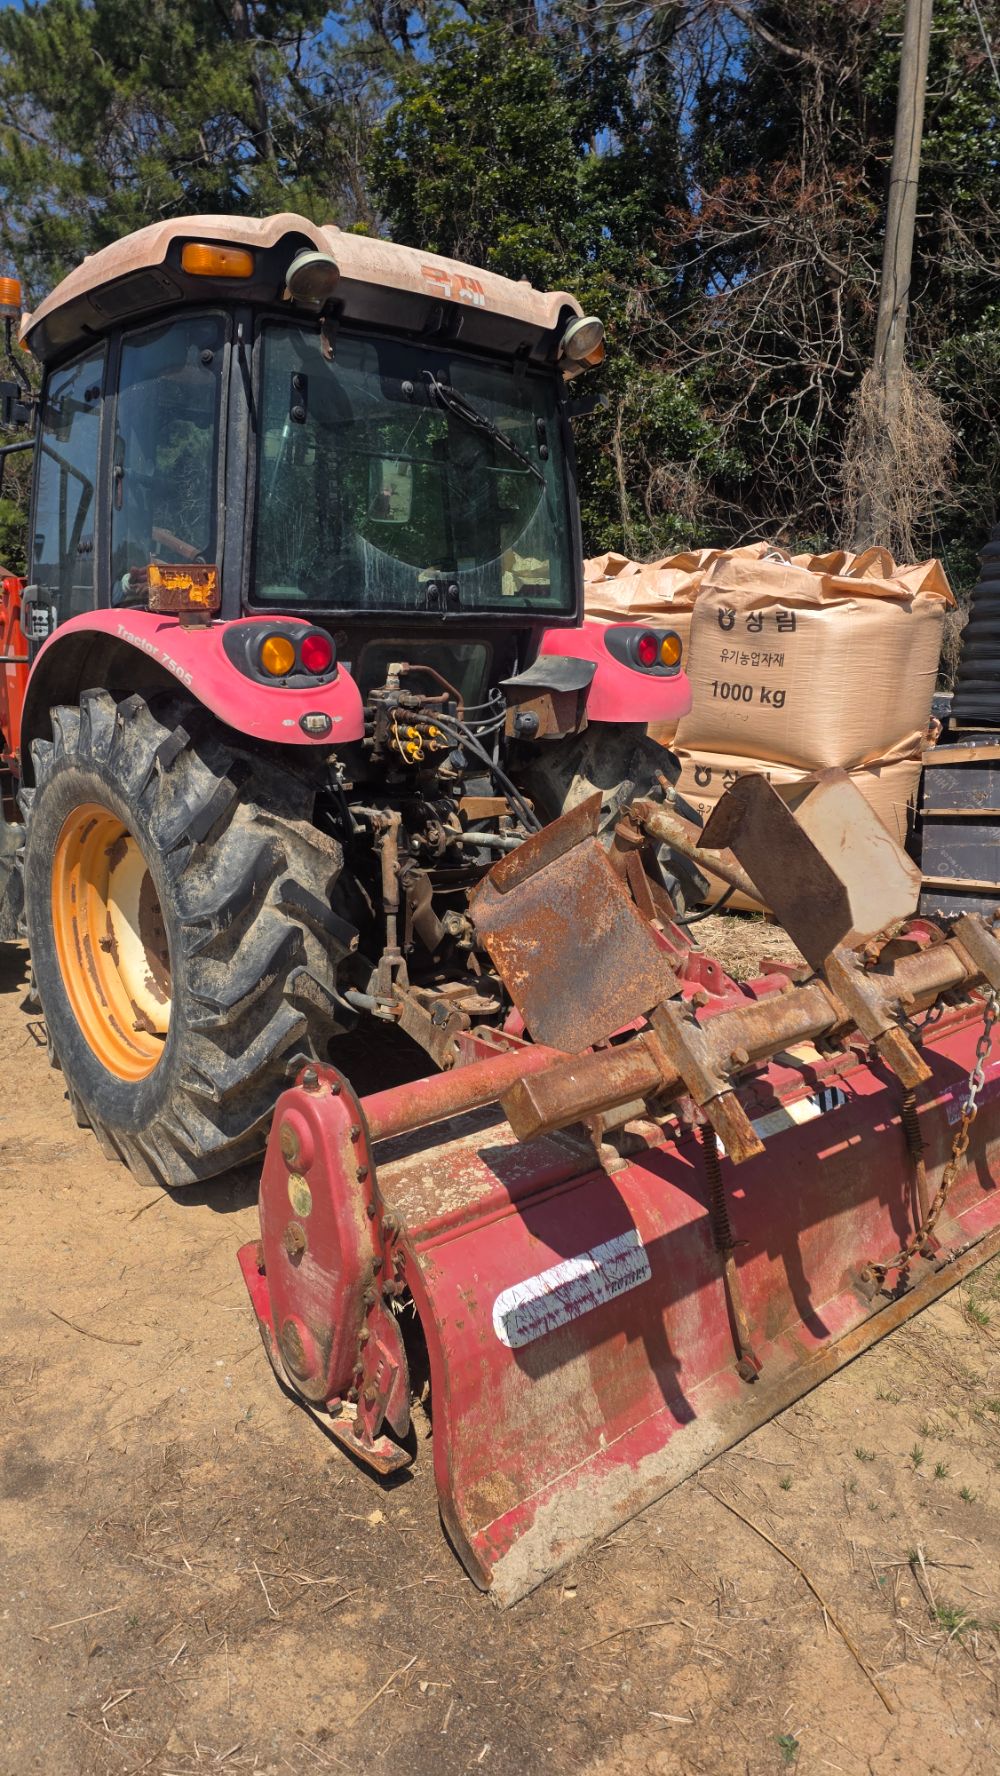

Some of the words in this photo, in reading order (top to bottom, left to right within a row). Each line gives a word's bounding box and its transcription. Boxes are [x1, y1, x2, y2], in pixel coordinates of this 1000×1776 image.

[421, 264, 485, 306] 국제
[117, 624, 159, 654] Tractor
[161, 652, 193, 686] 7505
[719, 648, 785, 667] 유기농업자재
[711, 680, 753, 702] 1000
[760, 686, 786, 708] kg
